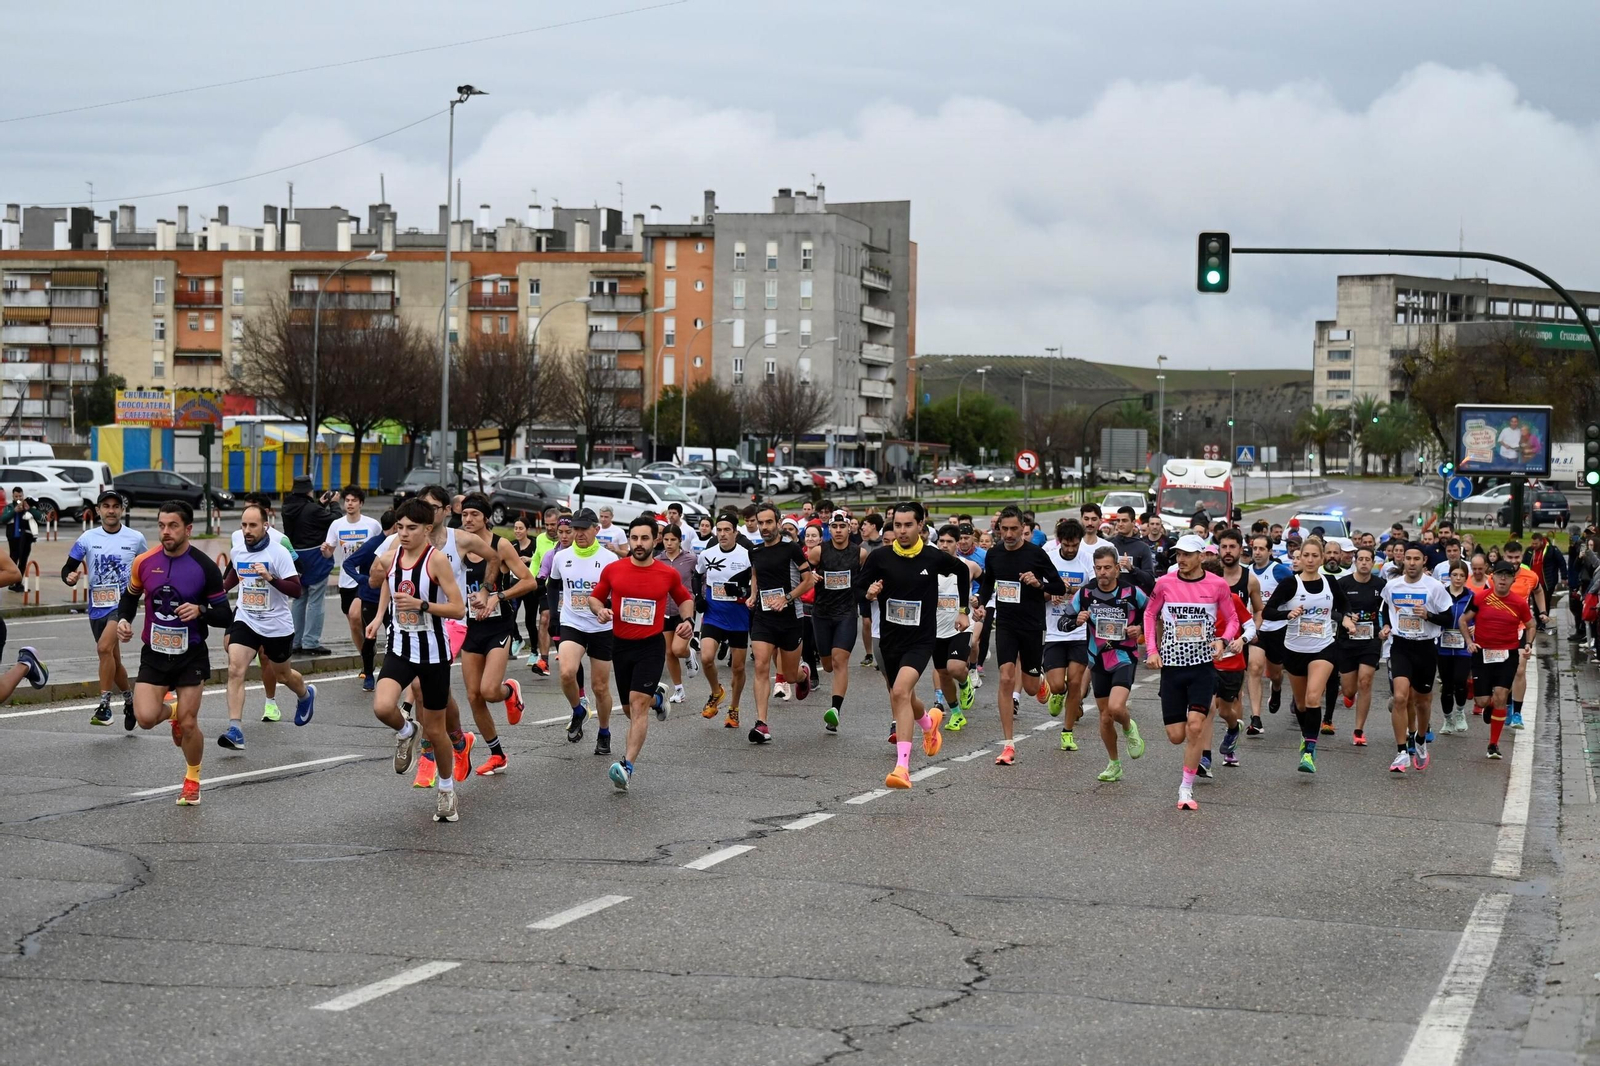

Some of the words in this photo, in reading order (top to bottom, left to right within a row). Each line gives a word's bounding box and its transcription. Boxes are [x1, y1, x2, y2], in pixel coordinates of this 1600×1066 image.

[117, 401, 171, 410] CHOCOLATERIA
[623, 604, 651, 619] 135
[896, 607, 905, 618] 1
[1168, 606, 1206, 614] ENTRENA
[1302, 604, 1329, 616] ndea
[398, 612, 420, 626] 89
[1105, 624, 1114, 634] 2
[1176, 626, 1202, 637] 309
[153, 632, 182, 648] 259
